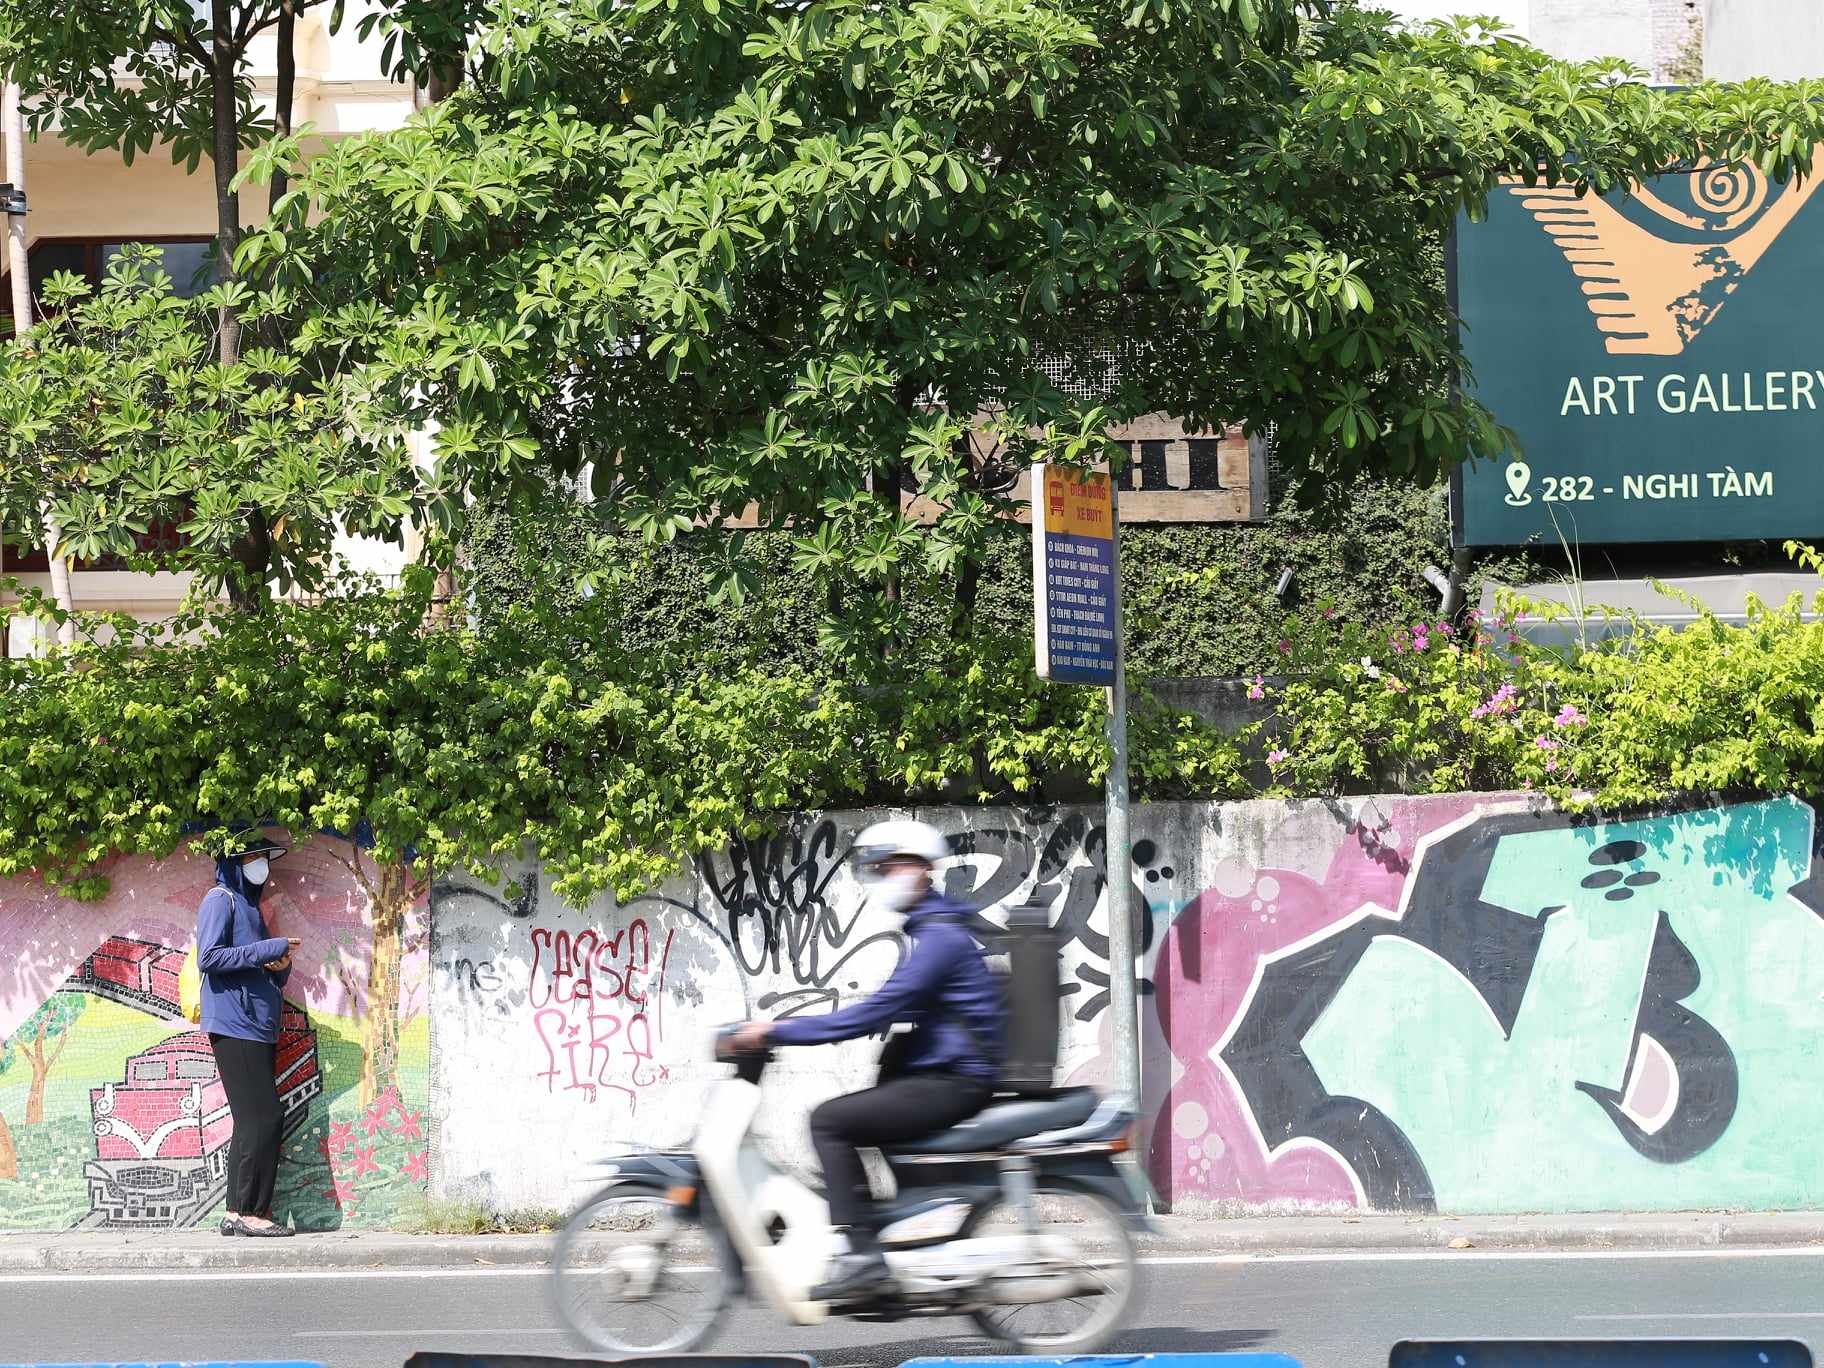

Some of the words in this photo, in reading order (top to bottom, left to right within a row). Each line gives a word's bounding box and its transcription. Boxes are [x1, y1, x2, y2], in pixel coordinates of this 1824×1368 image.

[1560, 375, 1645, 416] ART
[1541, 475, 1595, 502] 282
[1622, 473, 1699, 500] NGHI
[1706, 465, 1774, 497] TÀM
